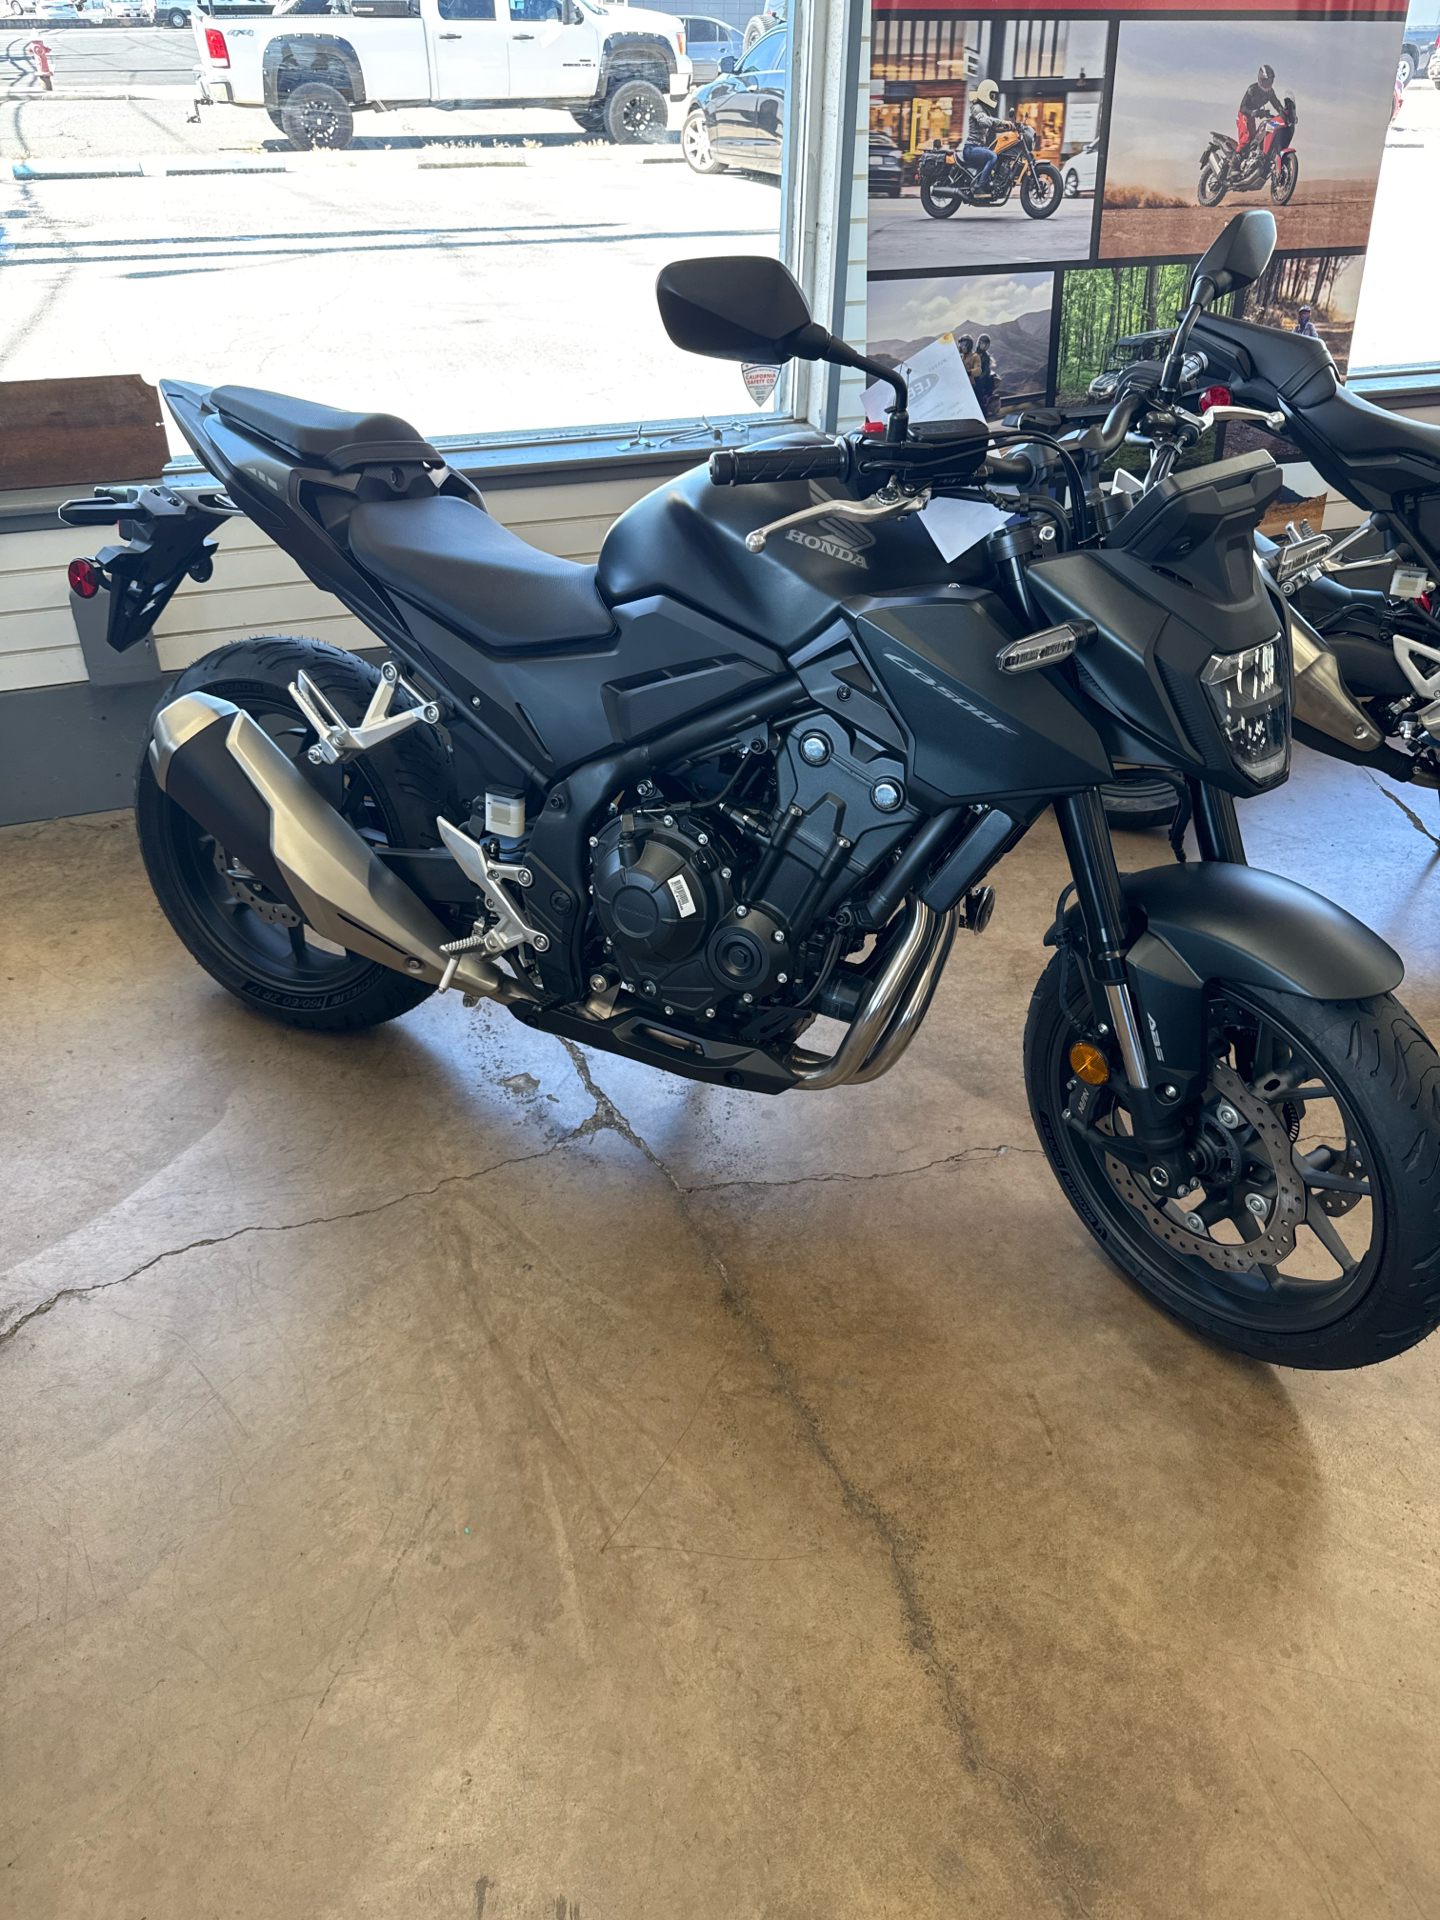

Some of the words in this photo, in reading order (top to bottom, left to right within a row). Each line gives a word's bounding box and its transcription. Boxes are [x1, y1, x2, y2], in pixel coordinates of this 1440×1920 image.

[785, 529, 869, 570] HONDA
[218, 683, 250, 693] ROAD
[883, 652, 1020, 736] CB500F
[248, 985, 260, 995] 17
[263, 991, 281, 1003] ZR
[331, 964, 383, 1005] MICHELIN
[282, 996, 322, 1009] 160/60
[1146, 1011, 1165, 1062] ABS
[1048, 1139, 1064, 1166] 120/70
[1063, 1174, 1097, 1223] MICHELIN
